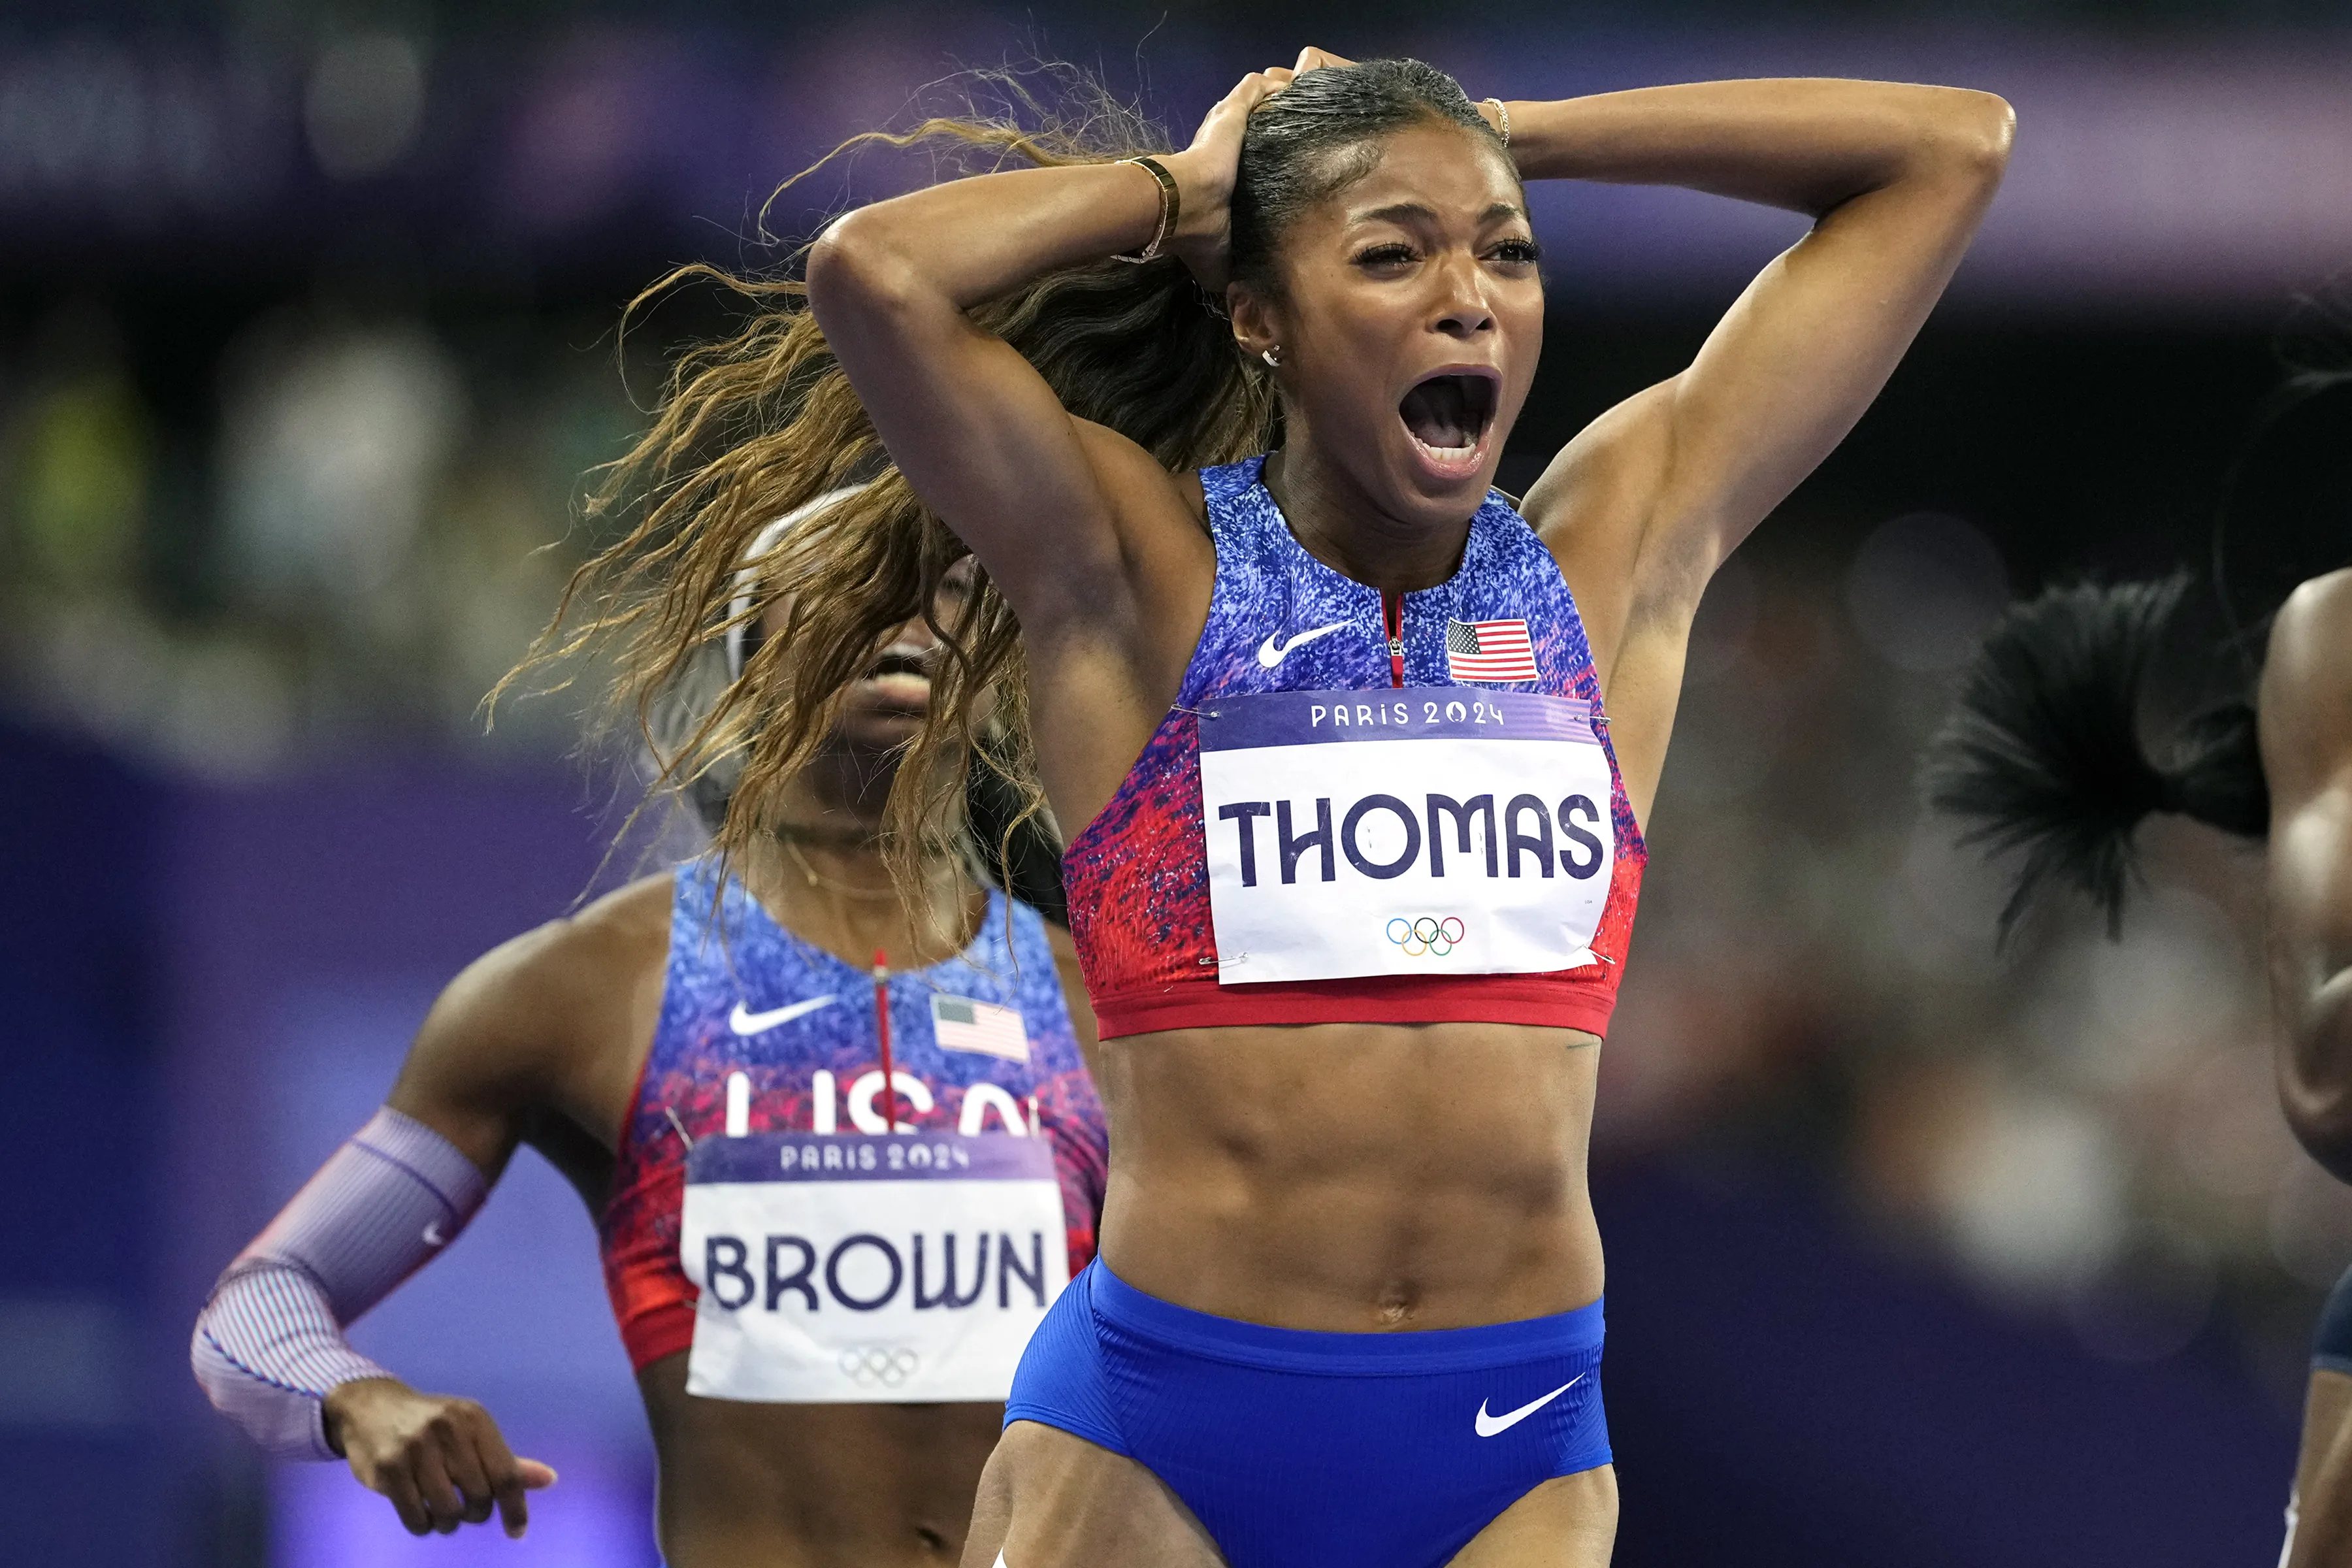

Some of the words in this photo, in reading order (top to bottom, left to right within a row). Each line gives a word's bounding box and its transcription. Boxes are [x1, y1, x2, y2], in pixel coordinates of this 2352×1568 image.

[1423, 701, 1504, 725] 2024
[1218, 793, 1604, 888] THOMAS
[887, 1143, 970, 1171] 2024
[704, 1232, 1048, 1313] BROWN
